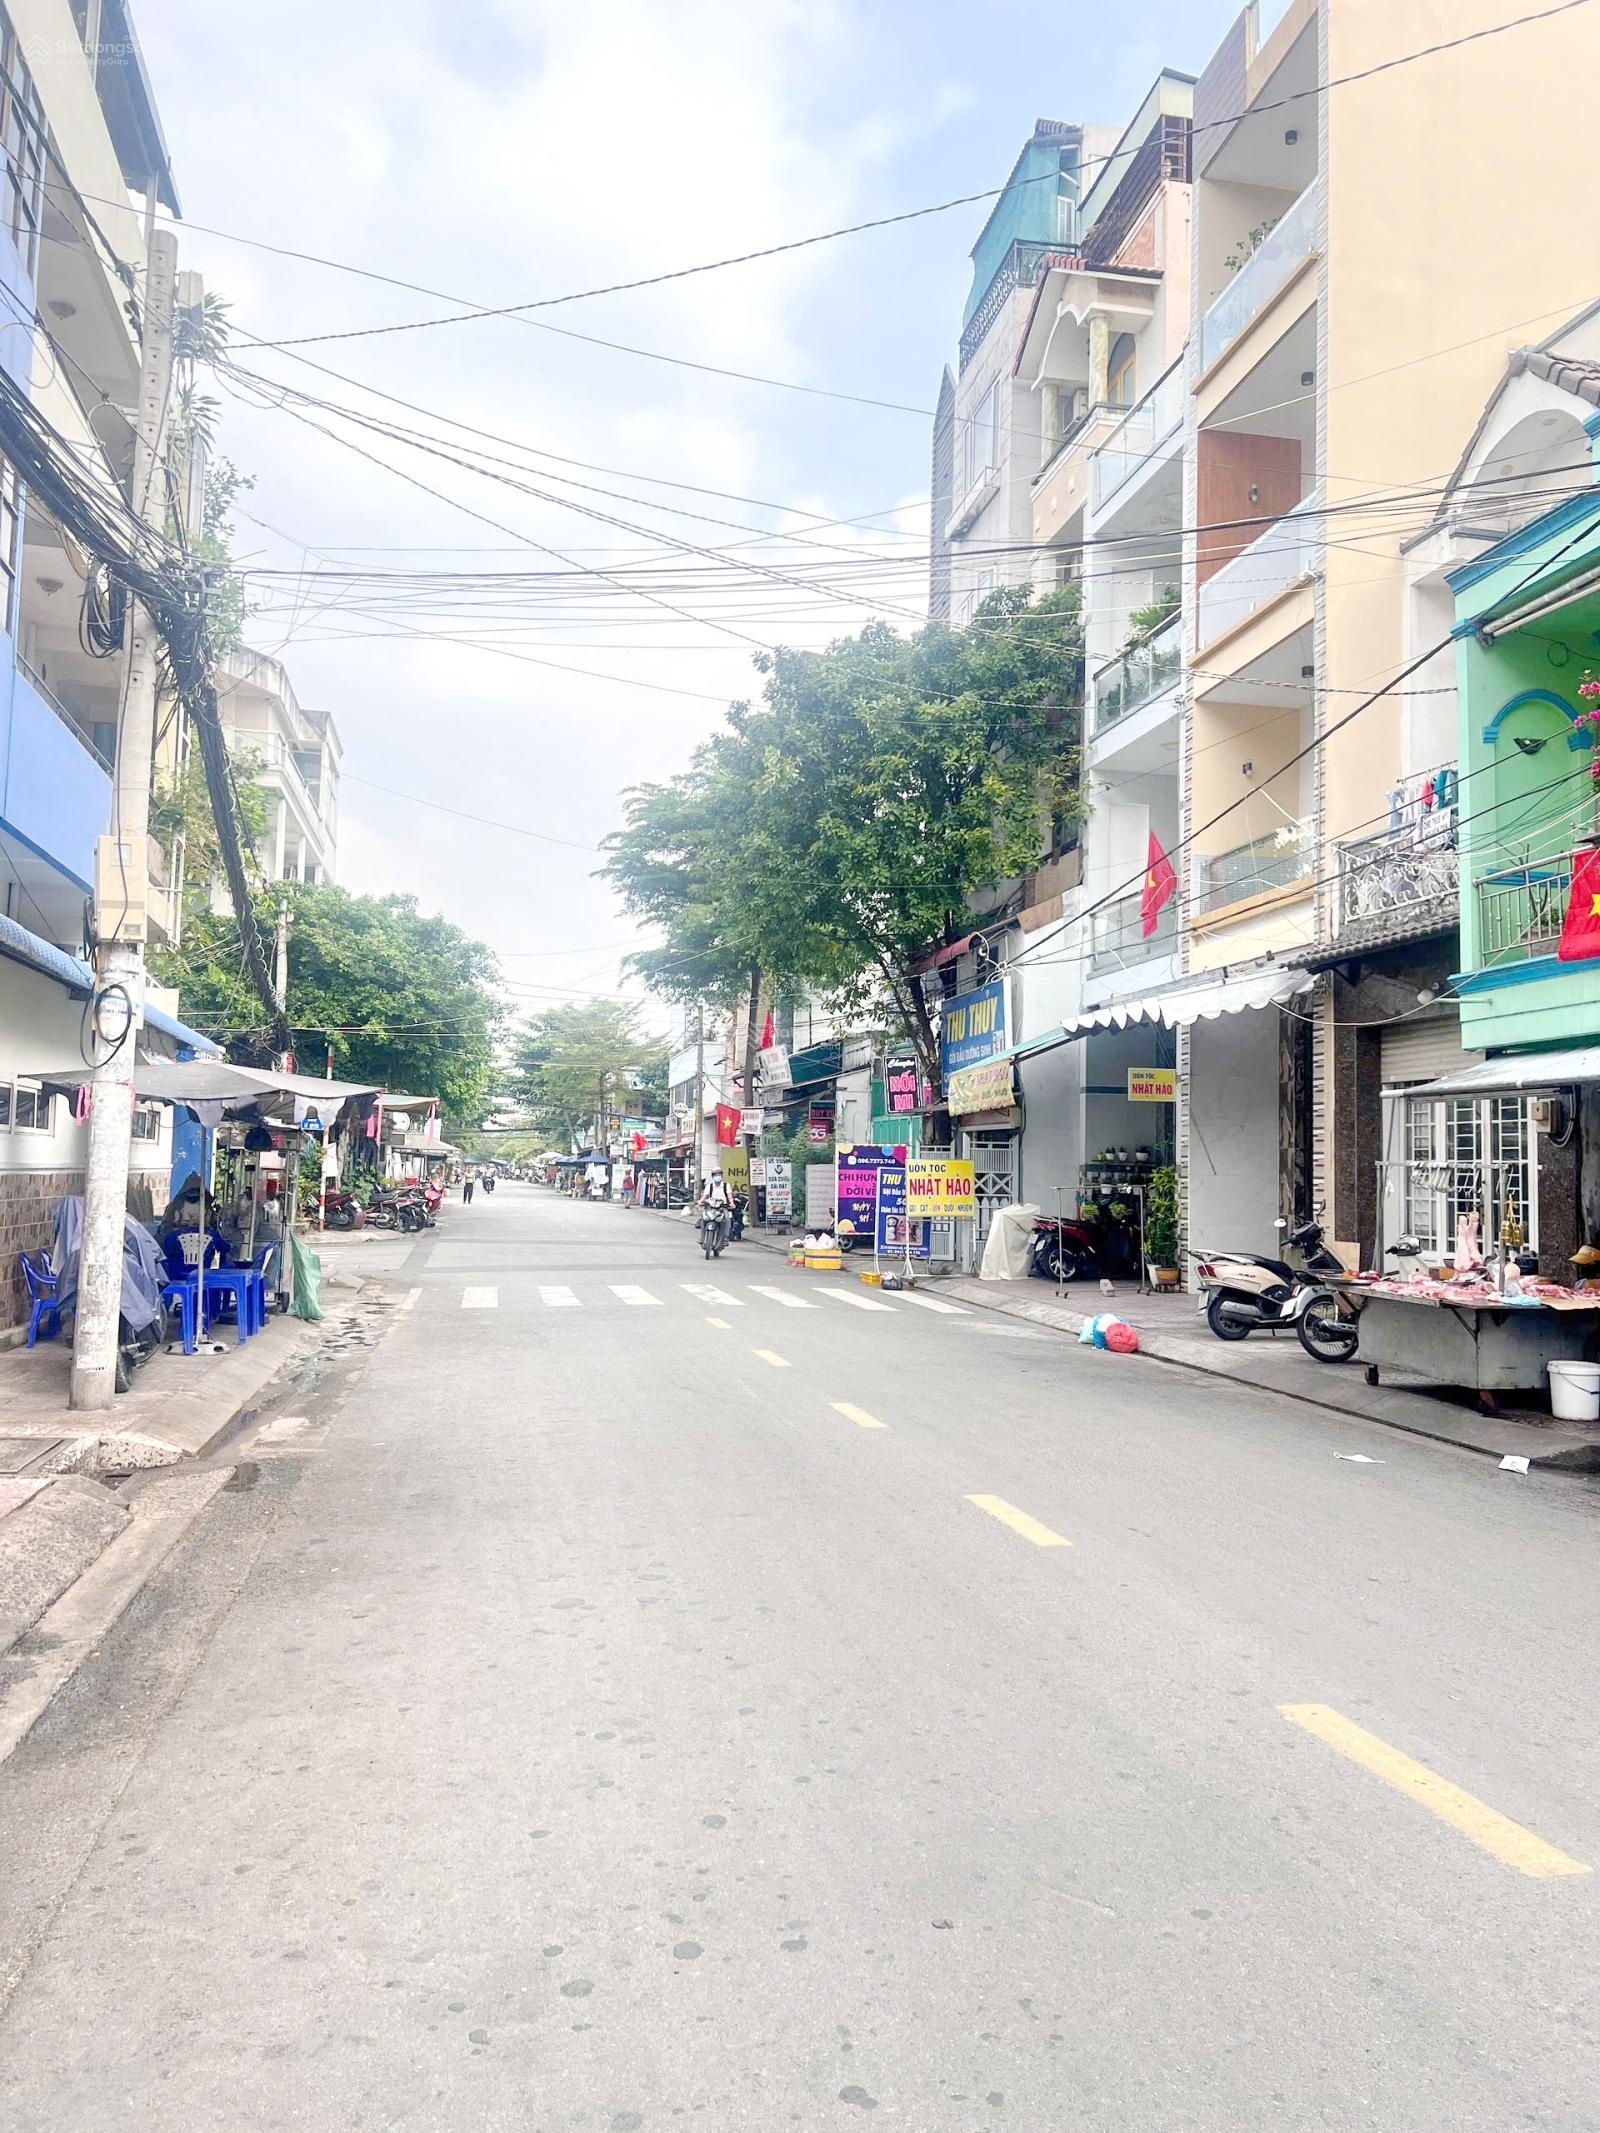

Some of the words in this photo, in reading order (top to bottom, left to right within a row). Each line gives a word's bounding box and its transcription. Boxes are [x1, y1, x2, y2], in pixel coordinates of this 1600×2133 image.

[947, 1008, 966, 1044] THU
[889, 1069, 916, 1092] NỐI
[809, 1127, 826, 1140] 5G
[882, 1173, 902, 1185] THU
[910, 1173, 942, 1199] NHẬT
[946, 1173, 971, 1196] HÀO
